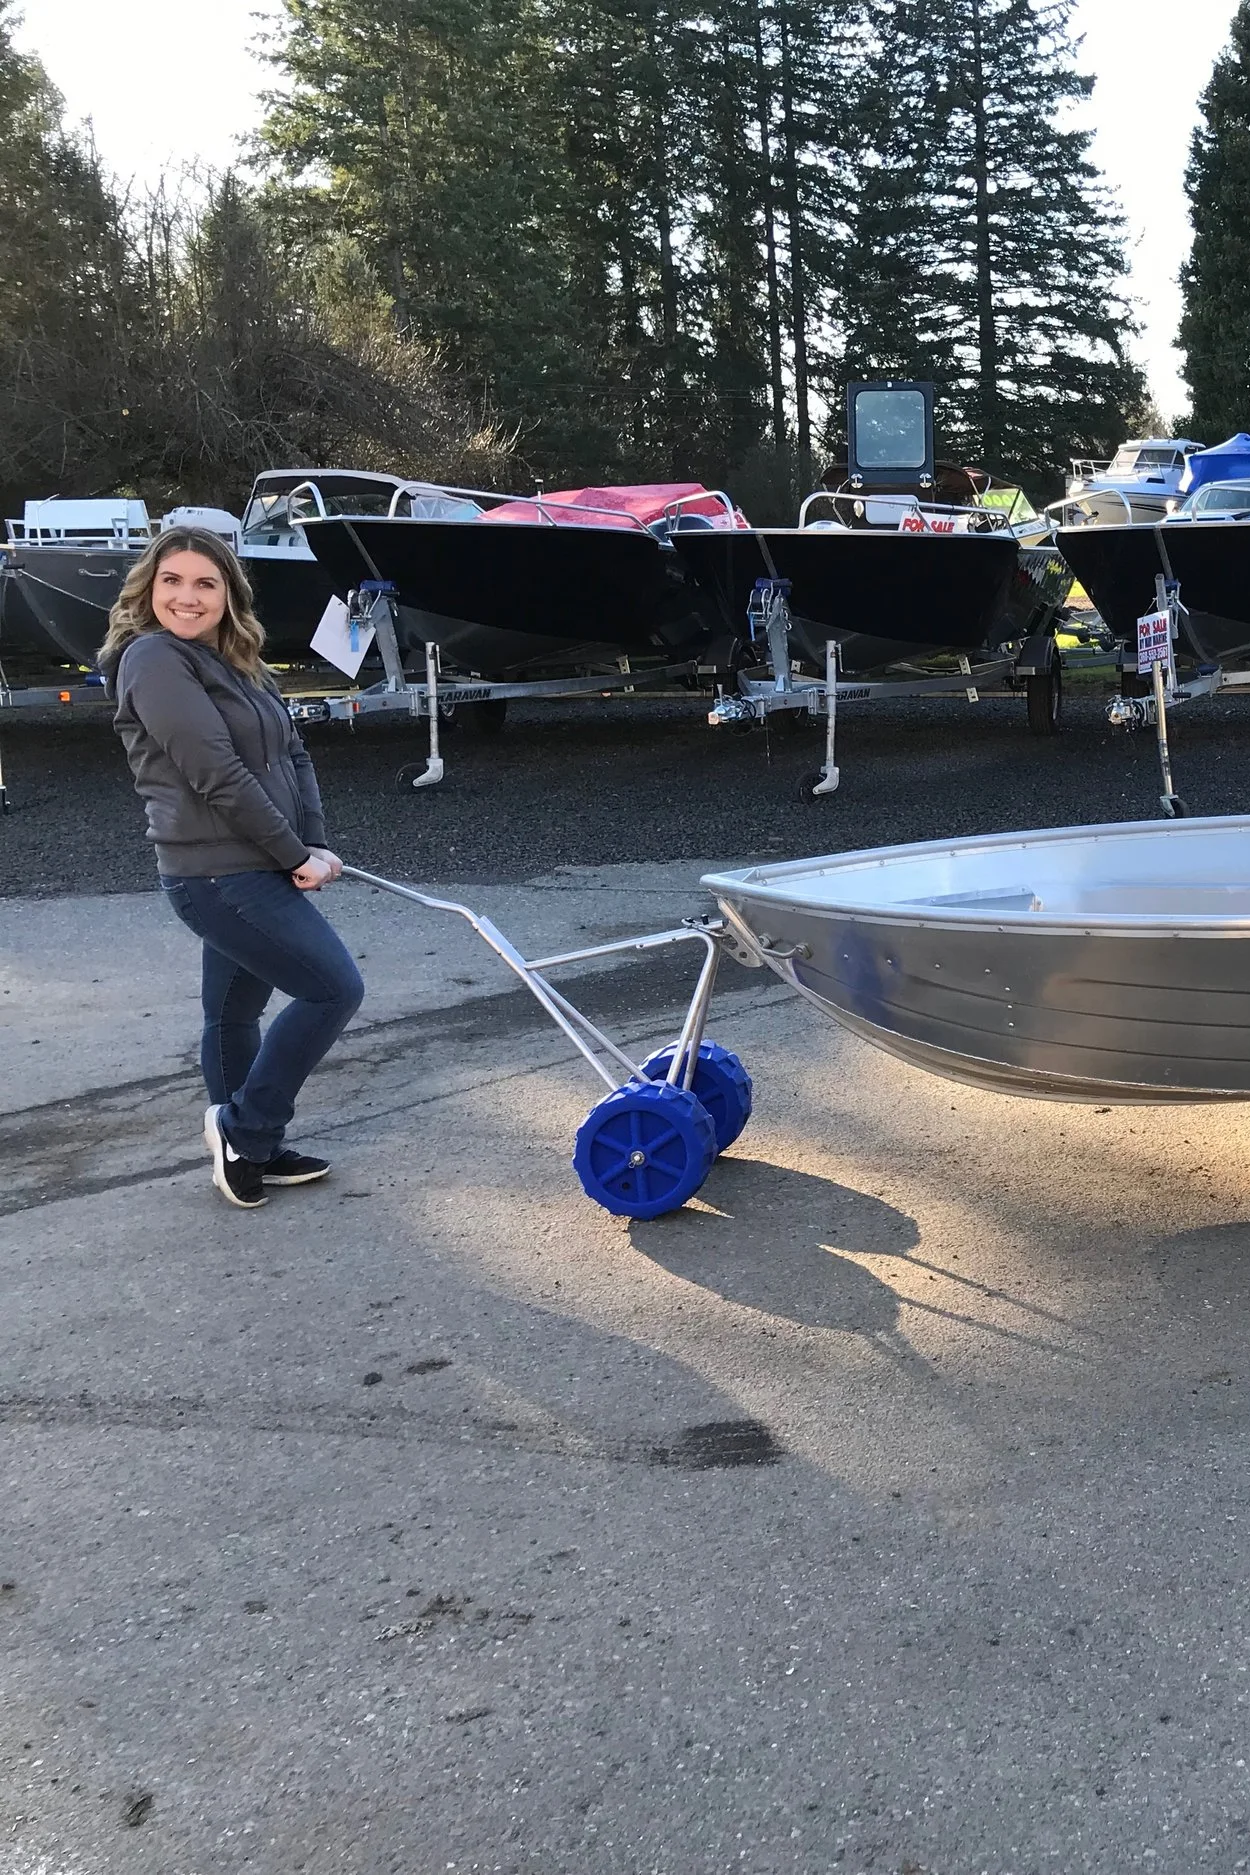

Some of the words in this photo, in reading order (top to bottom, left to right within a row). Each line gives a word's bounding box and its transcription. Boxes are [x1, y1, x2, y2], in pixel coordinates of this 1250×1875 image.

[902, 517, 926, 532] FOR
[930, 520, 955, 534] SALE
[1139, 623, 1150, 638] FOR
[1153, 618, 1167, 633] SALE
[835, 688, 871, 701] ARAVAN
